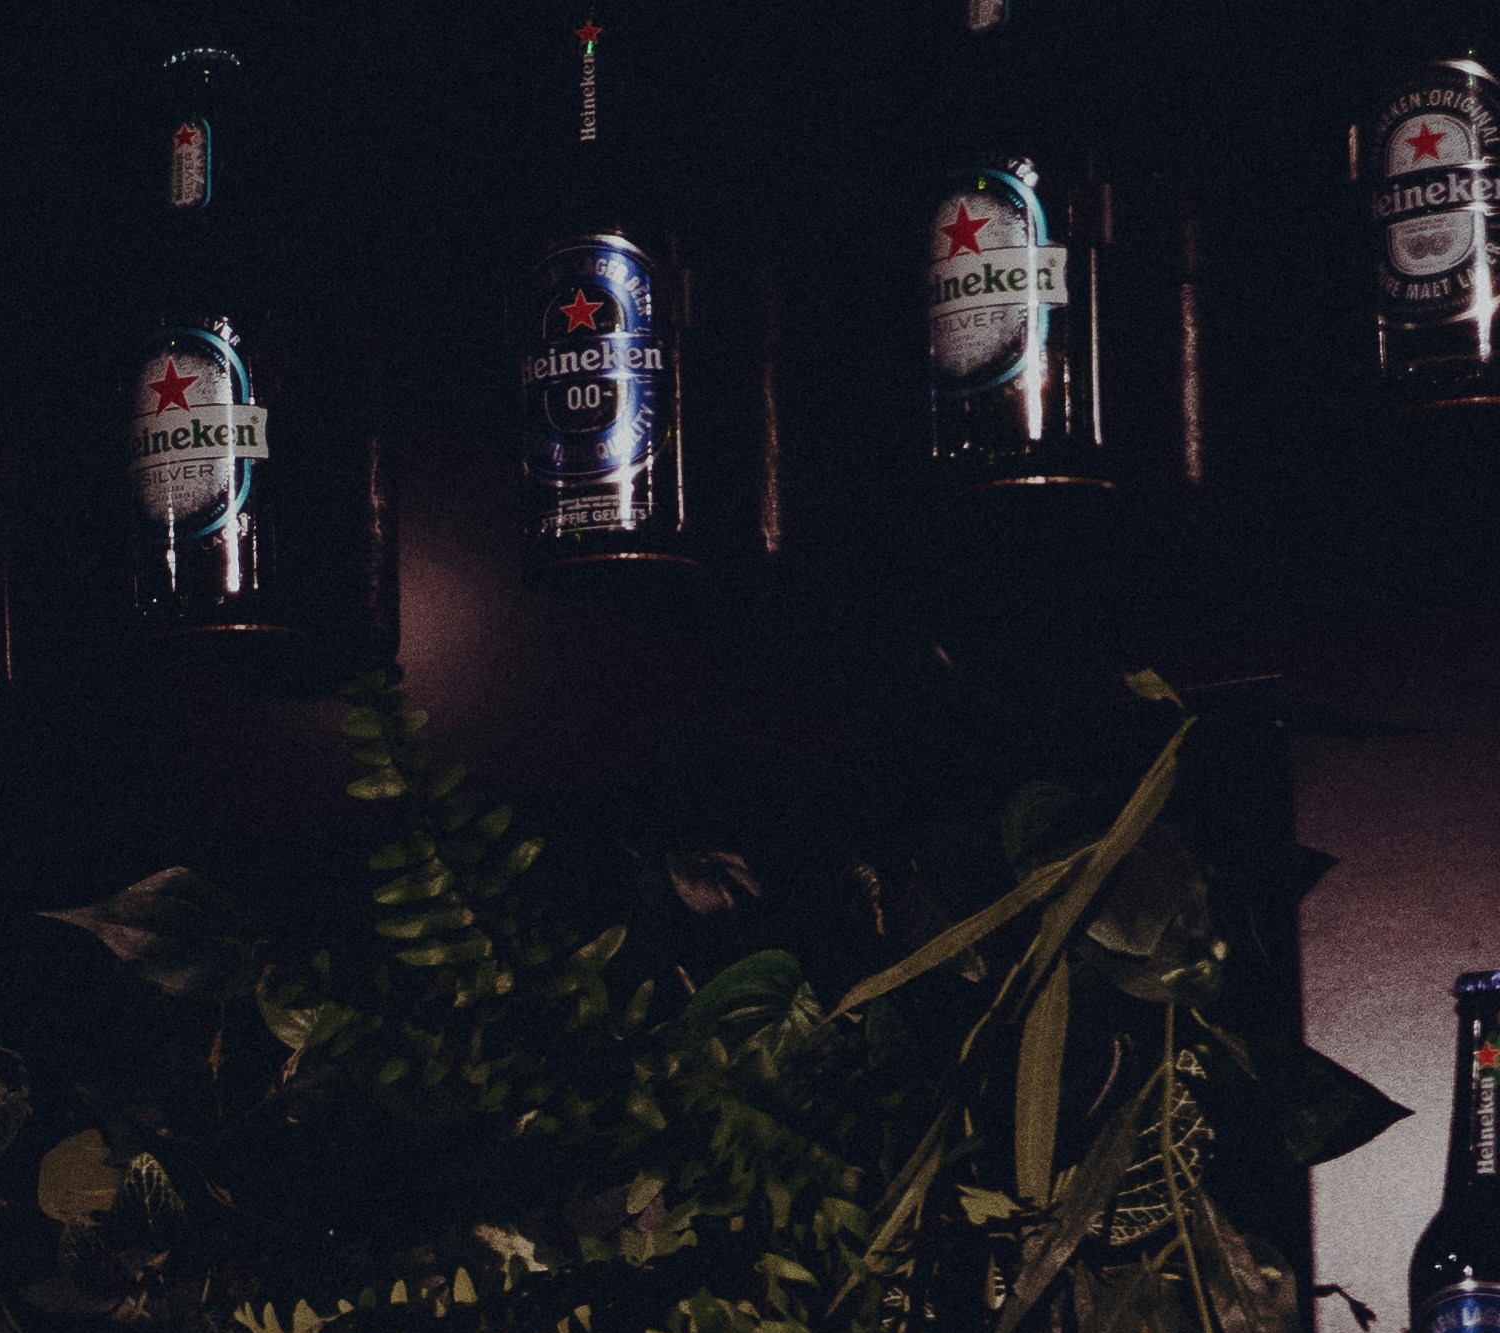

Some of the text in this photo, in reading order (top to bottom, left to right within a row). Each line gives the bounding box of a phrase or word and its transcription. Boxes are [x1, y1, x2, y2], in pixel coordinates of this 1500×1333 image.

[580, 54, 596, 141] Heineken
[1378, 173, 1500, 217] eineke
[131, 418, 258, 460] eineken
[1476, 1076, 1496, 1176] Heineken
